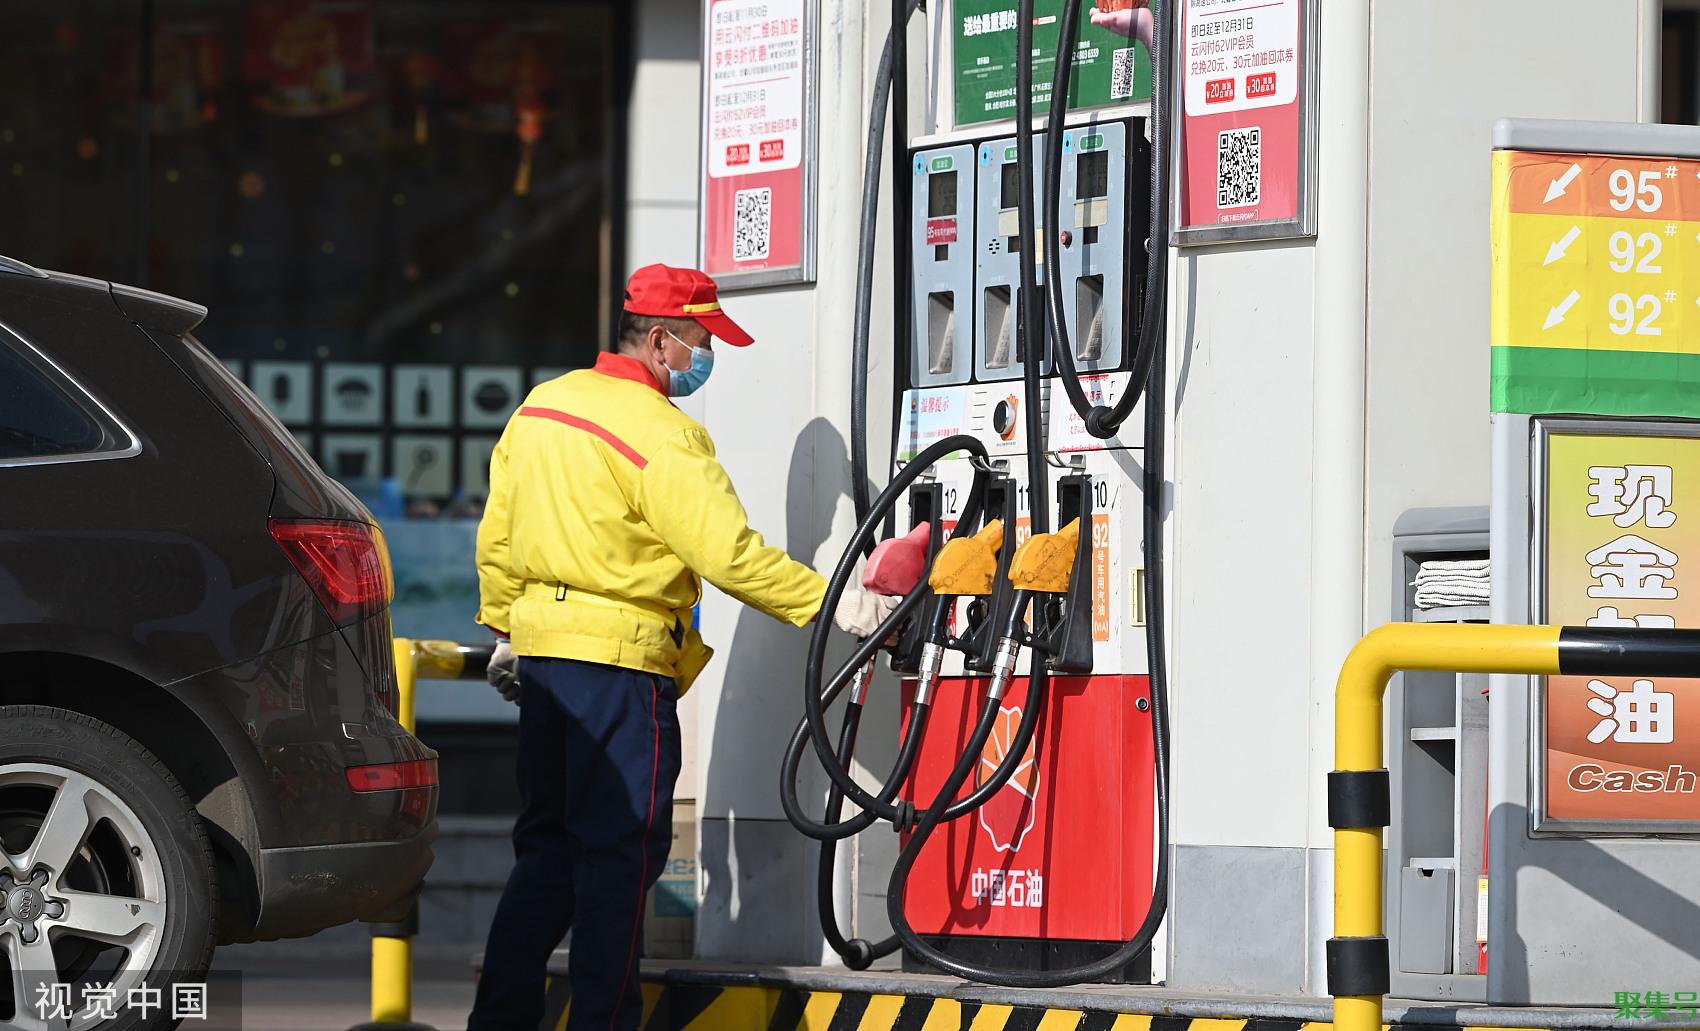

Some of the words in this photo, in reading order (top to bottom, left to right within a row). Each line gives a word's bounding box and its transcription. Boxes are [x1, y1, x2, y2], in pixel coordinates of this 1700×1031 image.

[1191, 17, 1254, 38] 即日起至12月31日
[1191, 34, 1254, 57] 云闪付62VIP会员
[944, 488, 957, 514] 12
[1093, 480, 1108, 508] 10
[1093, 522, 1108, 549] 92
[1585, 464, 1679, 744] 现金油
[1567, 763, 1696, 793] Cash
[971, 867, 1043, 908] 中国石油
